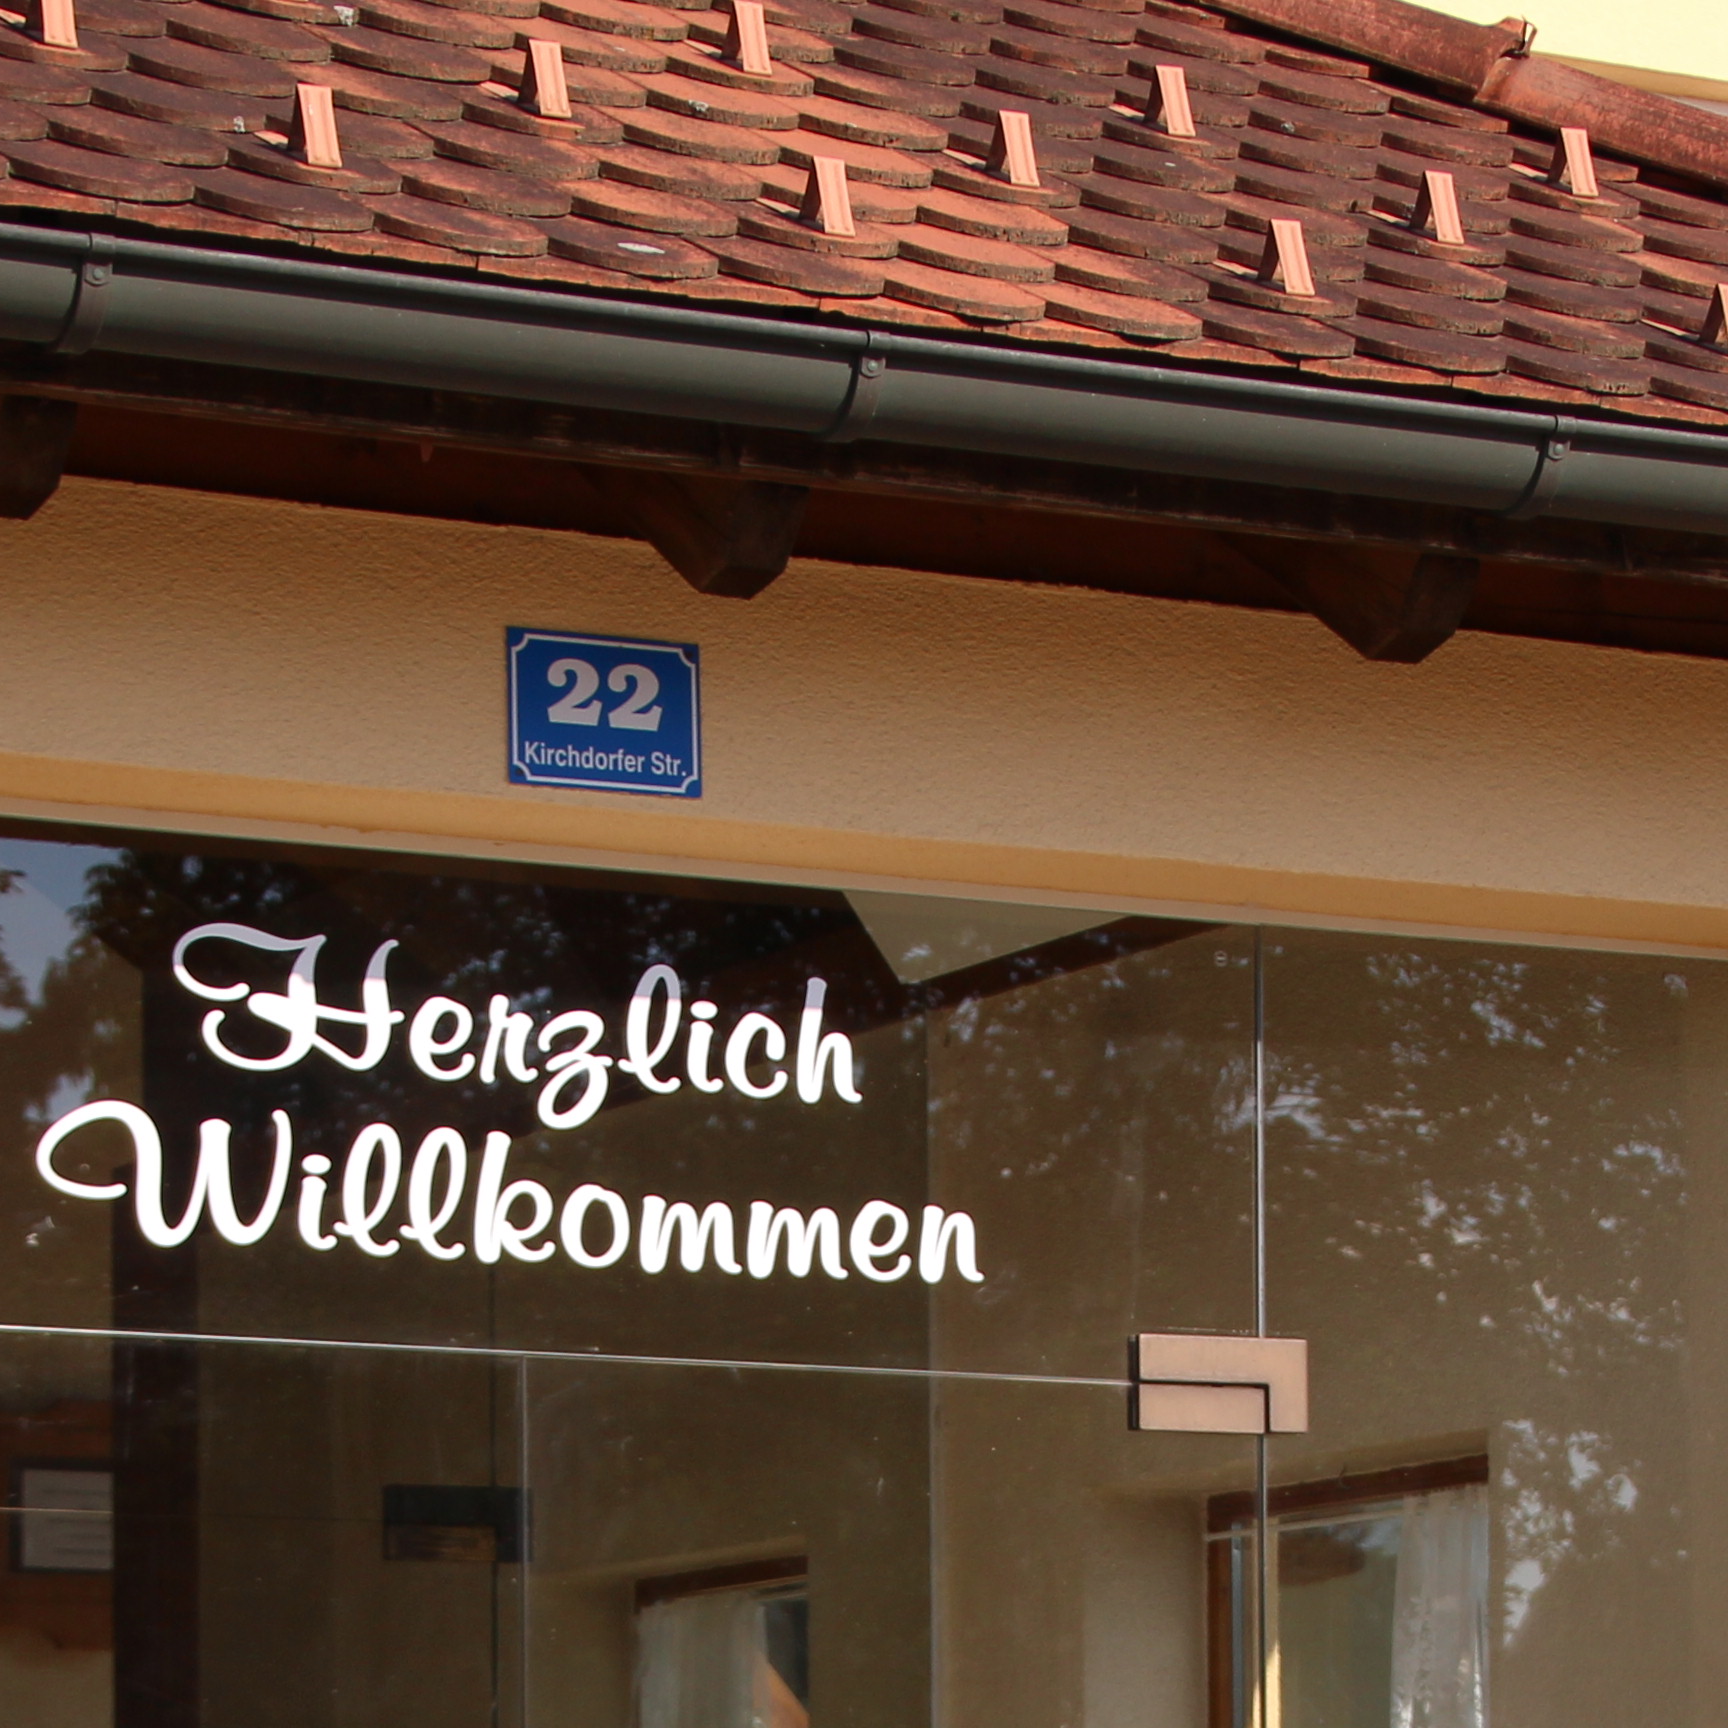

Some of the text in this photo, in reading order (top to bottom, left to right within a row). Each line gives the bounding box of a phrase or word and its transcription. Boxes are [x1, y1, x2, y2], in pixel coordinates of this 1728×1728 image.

[524, 741, 687, 777] Kirchdorfer Str.
[546, 657, 663, 732] 22
[172, 922, 864, 1129] Herzlich
[35, 1099, 986, 1285] Willkommen
